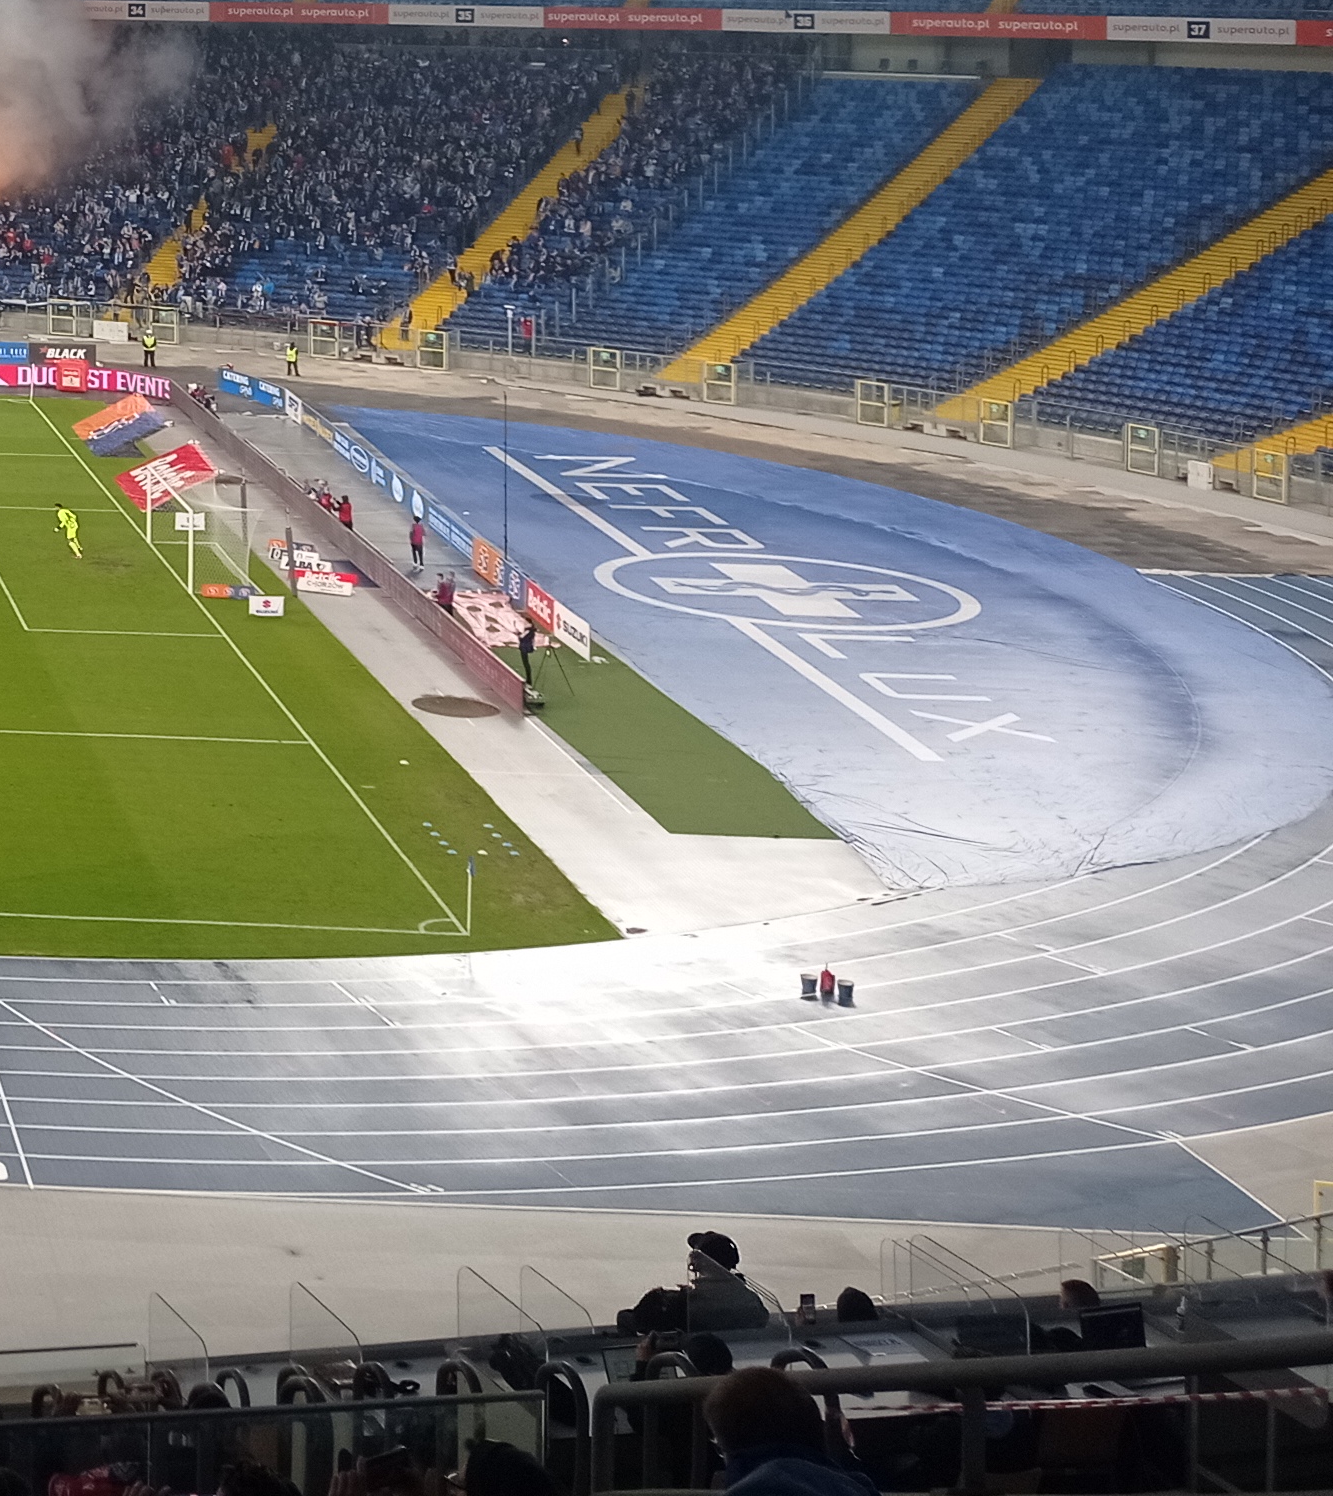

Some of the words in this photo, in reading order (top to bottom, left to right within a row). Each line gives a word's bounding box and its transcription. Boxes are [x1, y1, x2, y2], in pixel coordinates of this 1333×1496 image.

[130, 5, 144, 15] 34
[227, 7, 293, 18] superauto.pl
[301, 7, 368, 19] superauto.pl
[457, 10, 472, 20] 35
[548, 12, 620, 23] superauto.pl
[628, 12, 702, 25] superauto.pl
[912, 17, 989, 30] superauto.pl
[998, 19, 1078, 31] superauto.pl
[1112, 23, 1180, 34] superauto.pl
[1190, 22, 1206, 36] 37
[1217, 25, 1290, 37] superauto.pl
[46, 347, 87, 359] BLACK
[18, 366, 115, 392] DUOST
[528, 587, 552, 624] Betclic
[562, 620, 588, 648] SUZUKI
